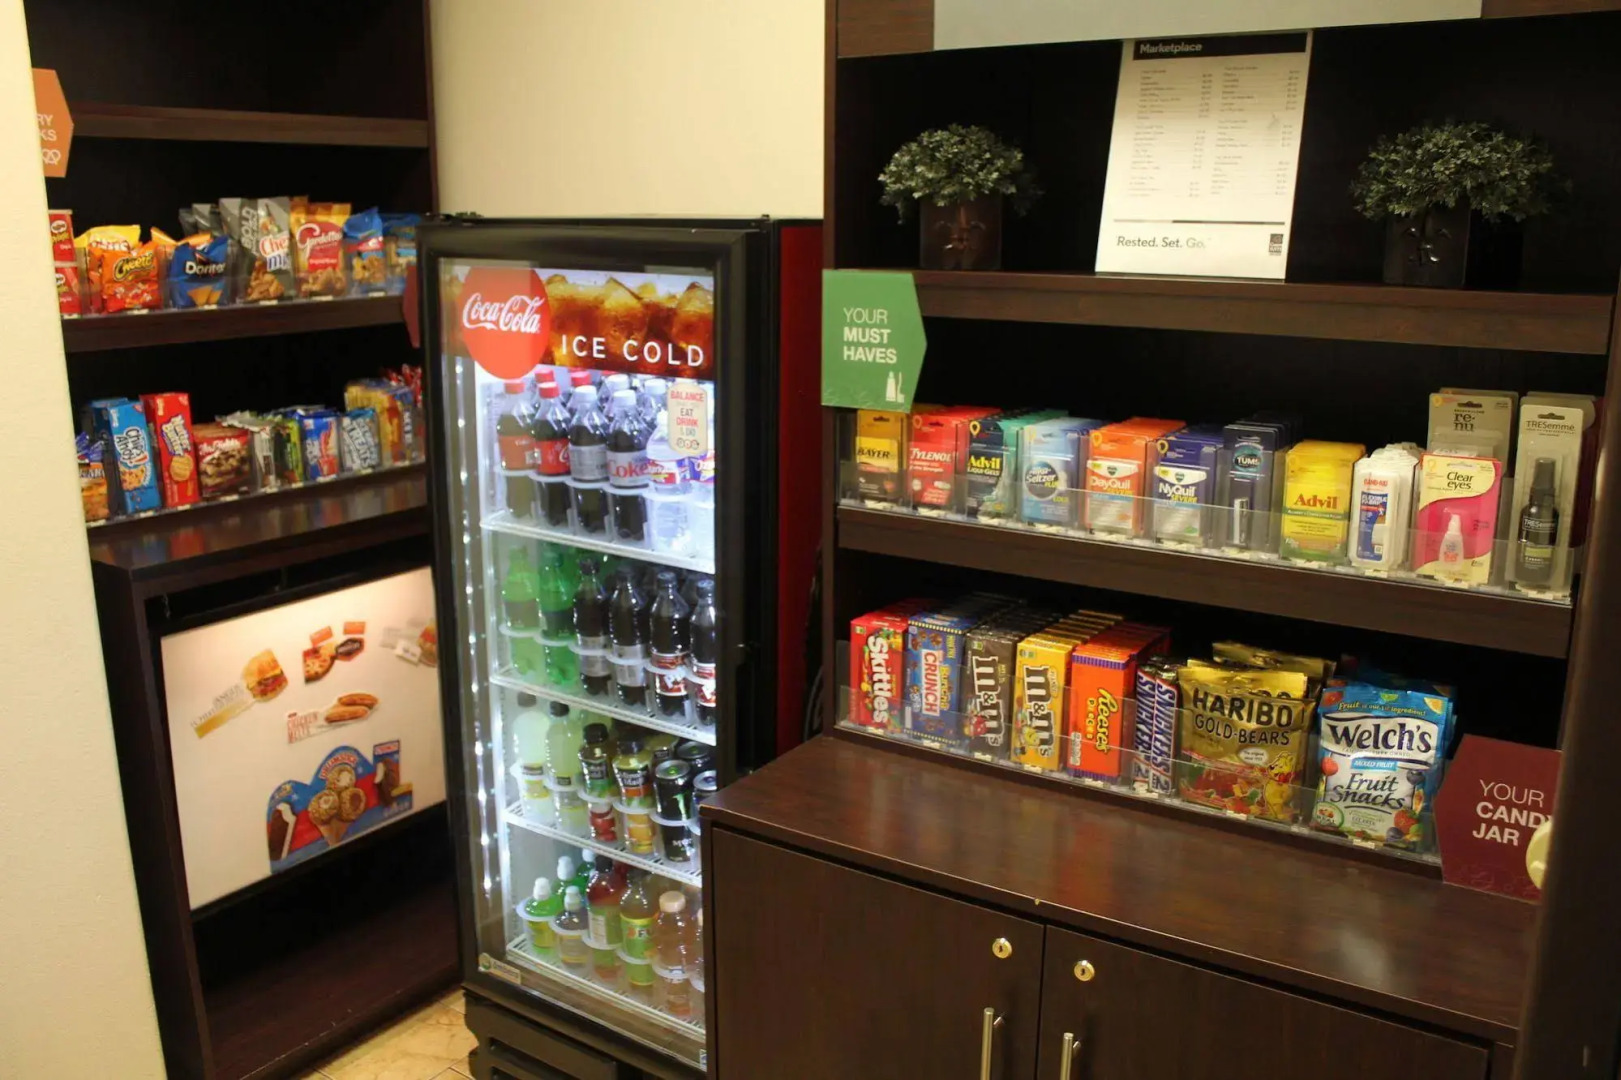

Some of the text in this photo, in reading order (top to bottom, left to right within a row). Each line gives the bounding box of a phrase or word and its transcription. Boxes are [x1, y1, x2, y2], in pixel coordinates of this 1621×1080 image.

[1139, 42, 1203, 56] Marketplace
[259, 234, 290, 257] Che
[1116, 235, 1206, 249] Rested. Set. Go.
[843, 308, 888, 324] YOUR
[843, 326, 891, 344] MUST
[561, 334, 705, 367] ICE COLD
[843, 346, 897, 364] HAVES
[670, 390, 705, 402] BALANCE
[680, 407, 694, 417] EAT
[1454, 421, 1475, 432] nu
[856, 447, 890, 459] BAYER
[910, 448, 952, 462] TYLENOL
[1236, 456, 1260, 466] TUMS
[968, 455, 1000, 469] Advil
[1090, 475, 1131, 490] DayQuil
[1446, 471, 1474, 482] Clear
[1158, 482, 1197, 497] NyQuil
[1447, 480, 1472, 491] eyes
[1294, 494, 1339, 510] Advil
[867, 635, 893, 724] Skittles
[923, 652, 939, 715] CRUNCH
[1192, 687, 1294, 729] HARIBO
[1338, 701, 1360, 711] Fruit
[1151, 680, 1177, 776] SNICKERS
[1195, 713, 1291, 746] GOLD-BEARS
[1326, 722, 1432, 753] Welch's
[1376, 761, 1395, 769] FRUIT
[1346, 772, 1399, 792] Fruit
[1330, 785, 1405, 810] Snacks
[1479, 779, 1545, 807] YOUR
[1472, 822, 1520, 846] JAR
